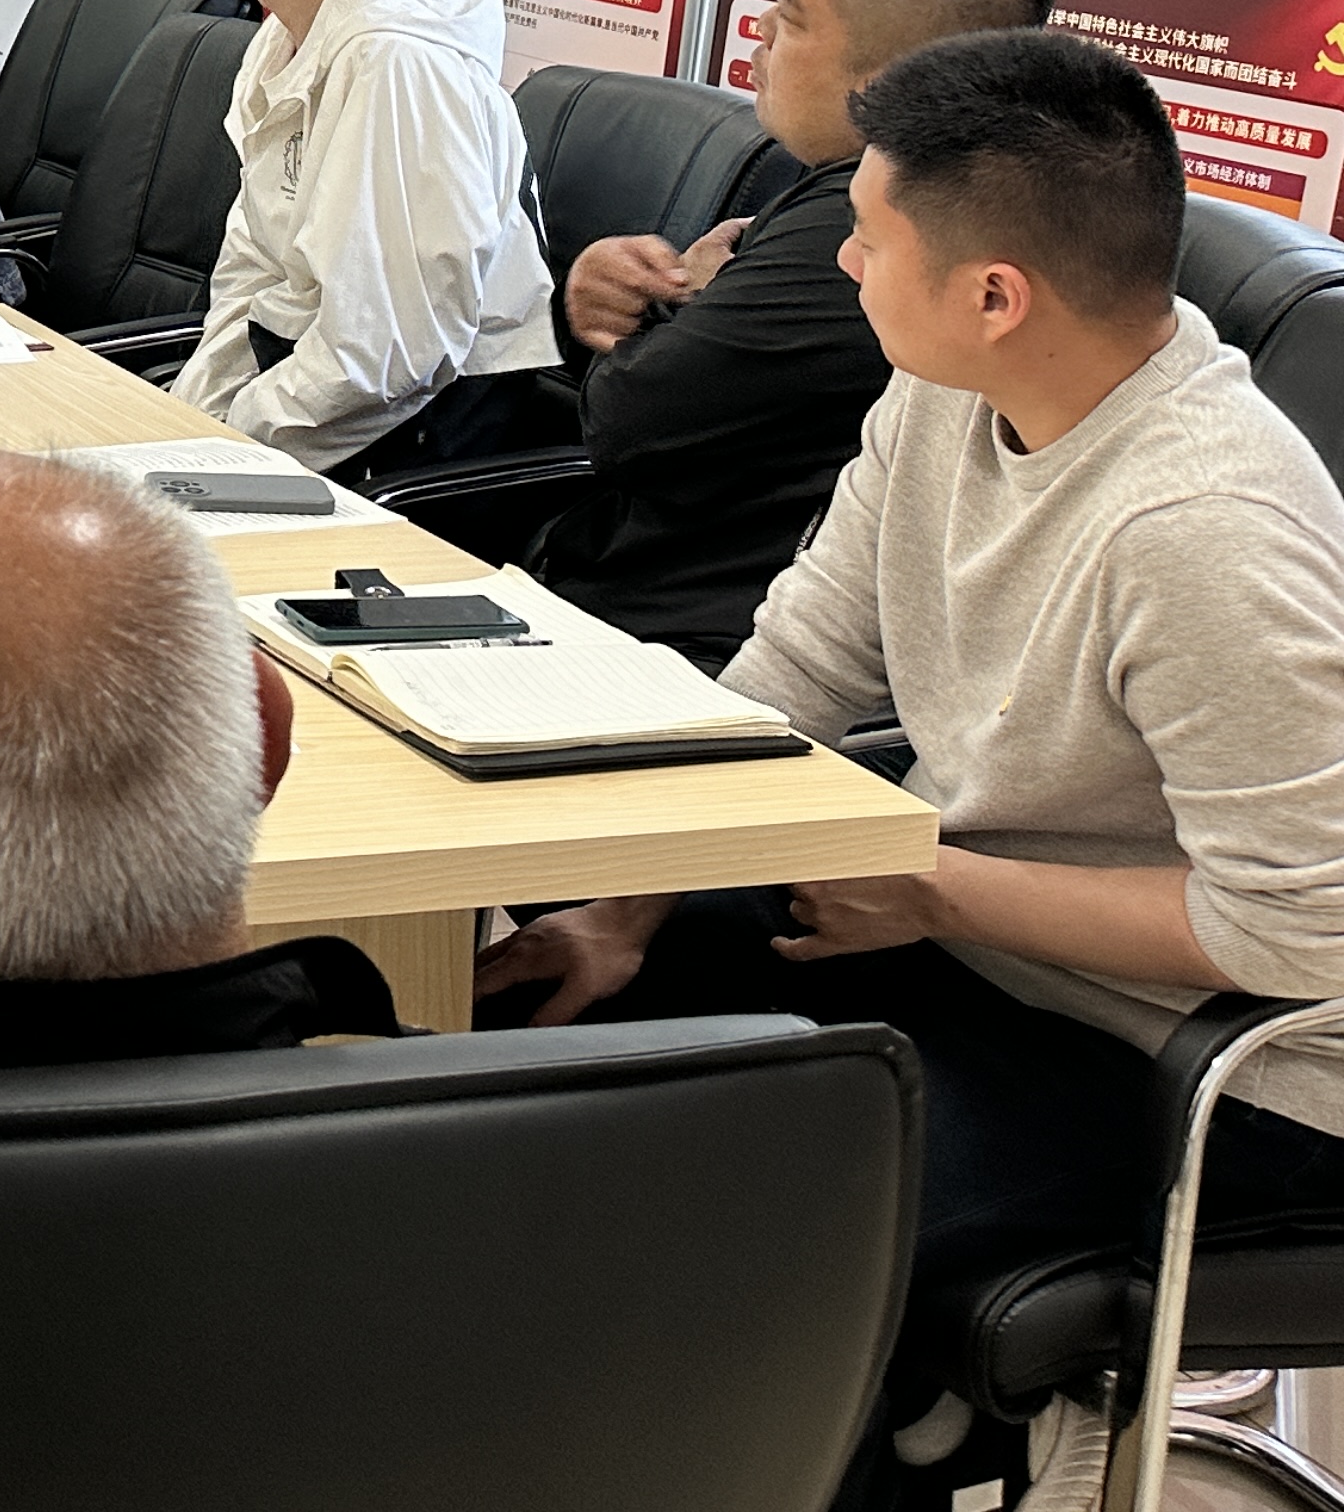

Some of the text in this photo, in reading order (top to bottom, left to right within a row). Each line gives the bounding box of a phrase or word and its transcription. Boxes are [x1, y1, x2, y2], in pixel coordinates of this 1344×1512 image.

[1183, 157, 1272, 191] 义市场经济体制
